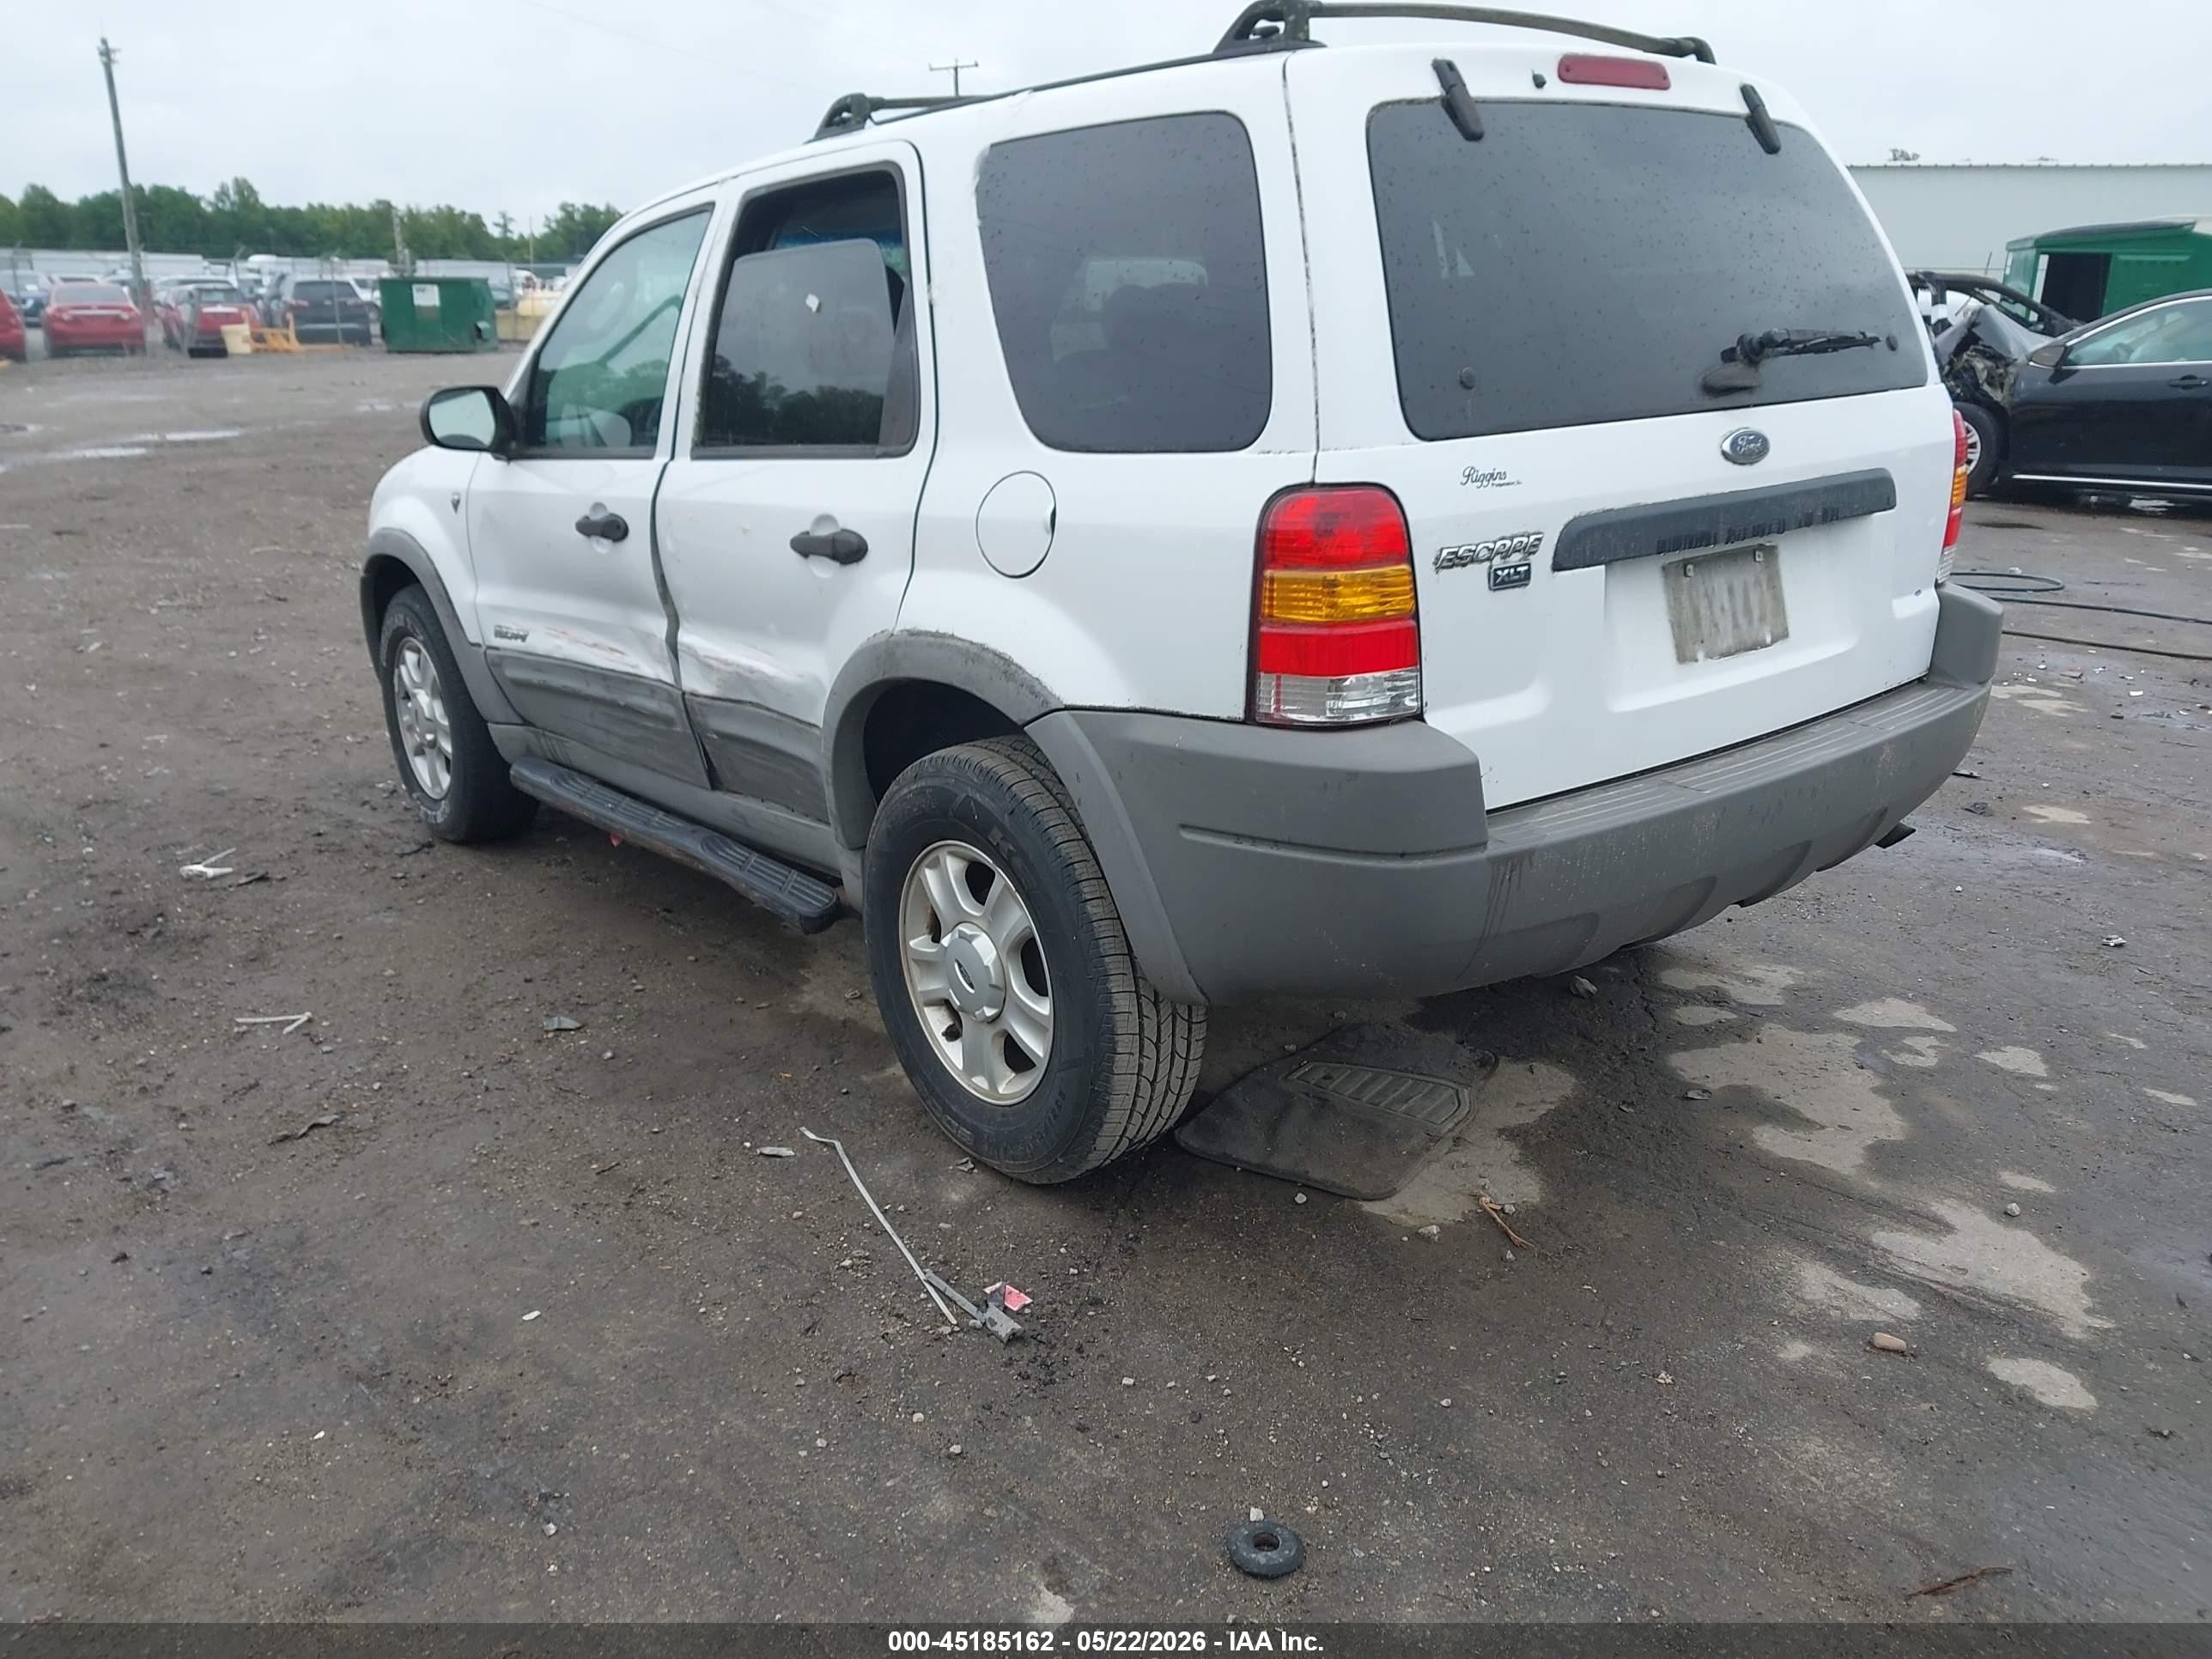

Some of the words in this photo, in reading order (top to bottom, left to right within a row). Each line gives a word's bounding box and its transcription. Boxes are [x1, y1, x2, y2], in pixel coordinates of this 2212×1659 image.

[1460, 465, 1507, 489] Riggins
[1432, 532, 1544, 573] ESCAPE
[1494, 565, 1530, 585] XLT
